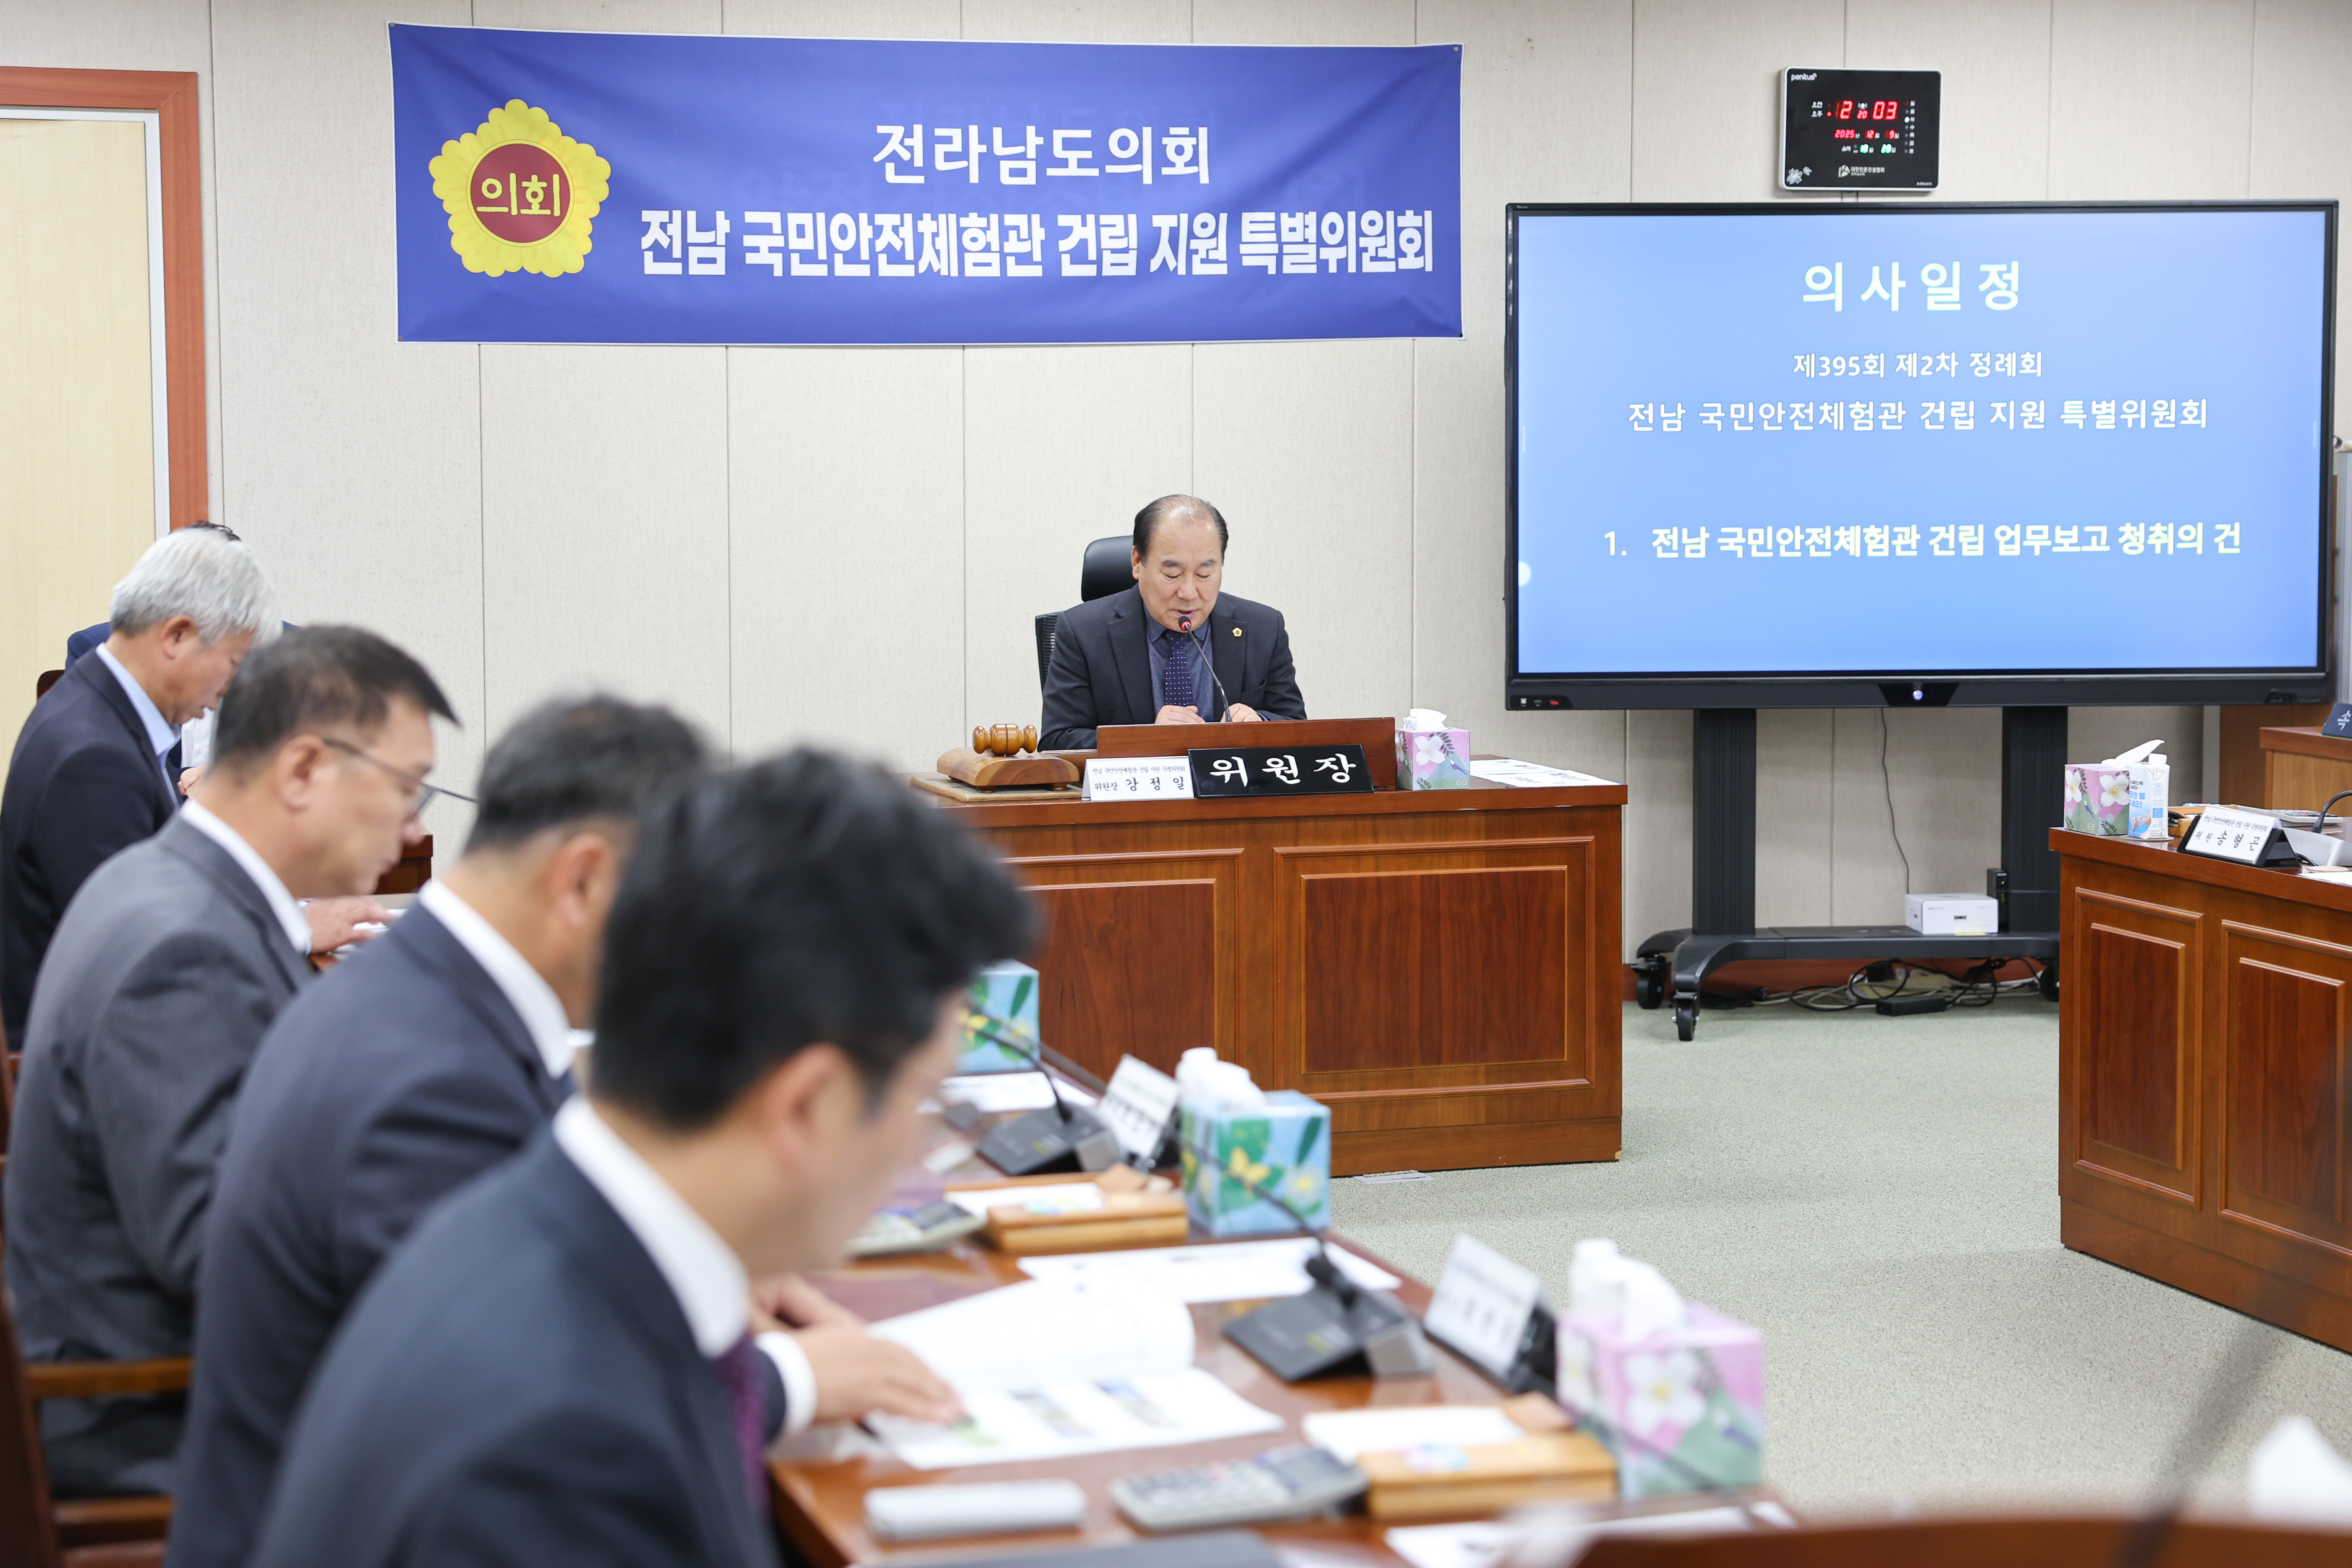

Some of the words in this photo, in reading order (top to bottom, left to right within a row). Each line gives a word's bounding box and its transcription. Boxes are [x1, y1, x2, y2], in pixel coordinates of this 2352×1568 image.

[1791, 73, 1815, 81] penitus
[1857, 110, 1868, 119] 20
[1872, 100, 1899, 120] 03
[872, 124, 1210, 185] 전라남도의회
[476, 173, 561, 217] 의회
[641, 210, 730, 275] 전남
[743, 211, 1046, 277] 국민안전체험관
[1057, 213, 1138, 277] 건립
[1150, 212, 1228, 275] 지원
[1239, 210, 1433, 275] 특별위원회
[1793, 352, 1885, 379] 제395회
[1895, 351, 1960, 379] 제2차
[1969, 351, 2043, 378] 정례회
[1628, 402, 1687, 432] 전남
[1698, 400, 1907, 432] 국민안전체험관
[1920, 400, 1976, 431] 건립
[1989, 399, 2045, 431] 지원
[2059, 398, 2208, 430] 특별위원회
[1604, 530, 1627, 556] 1.
[1651, 525, 1710, 558] 전남
[1717, 524, 1921, 558] 국민안전체험관
[1929, 524, 1986, 556] 건립
[1994, 523, 2111, 556] 업무보고
[2117, 522, 2204, 555] 청취의
[2213, 521, 2241, 554] 건
[1094, 782, 1118, 791] 위원장
[1210, 753, 1357, 787] 위원장
